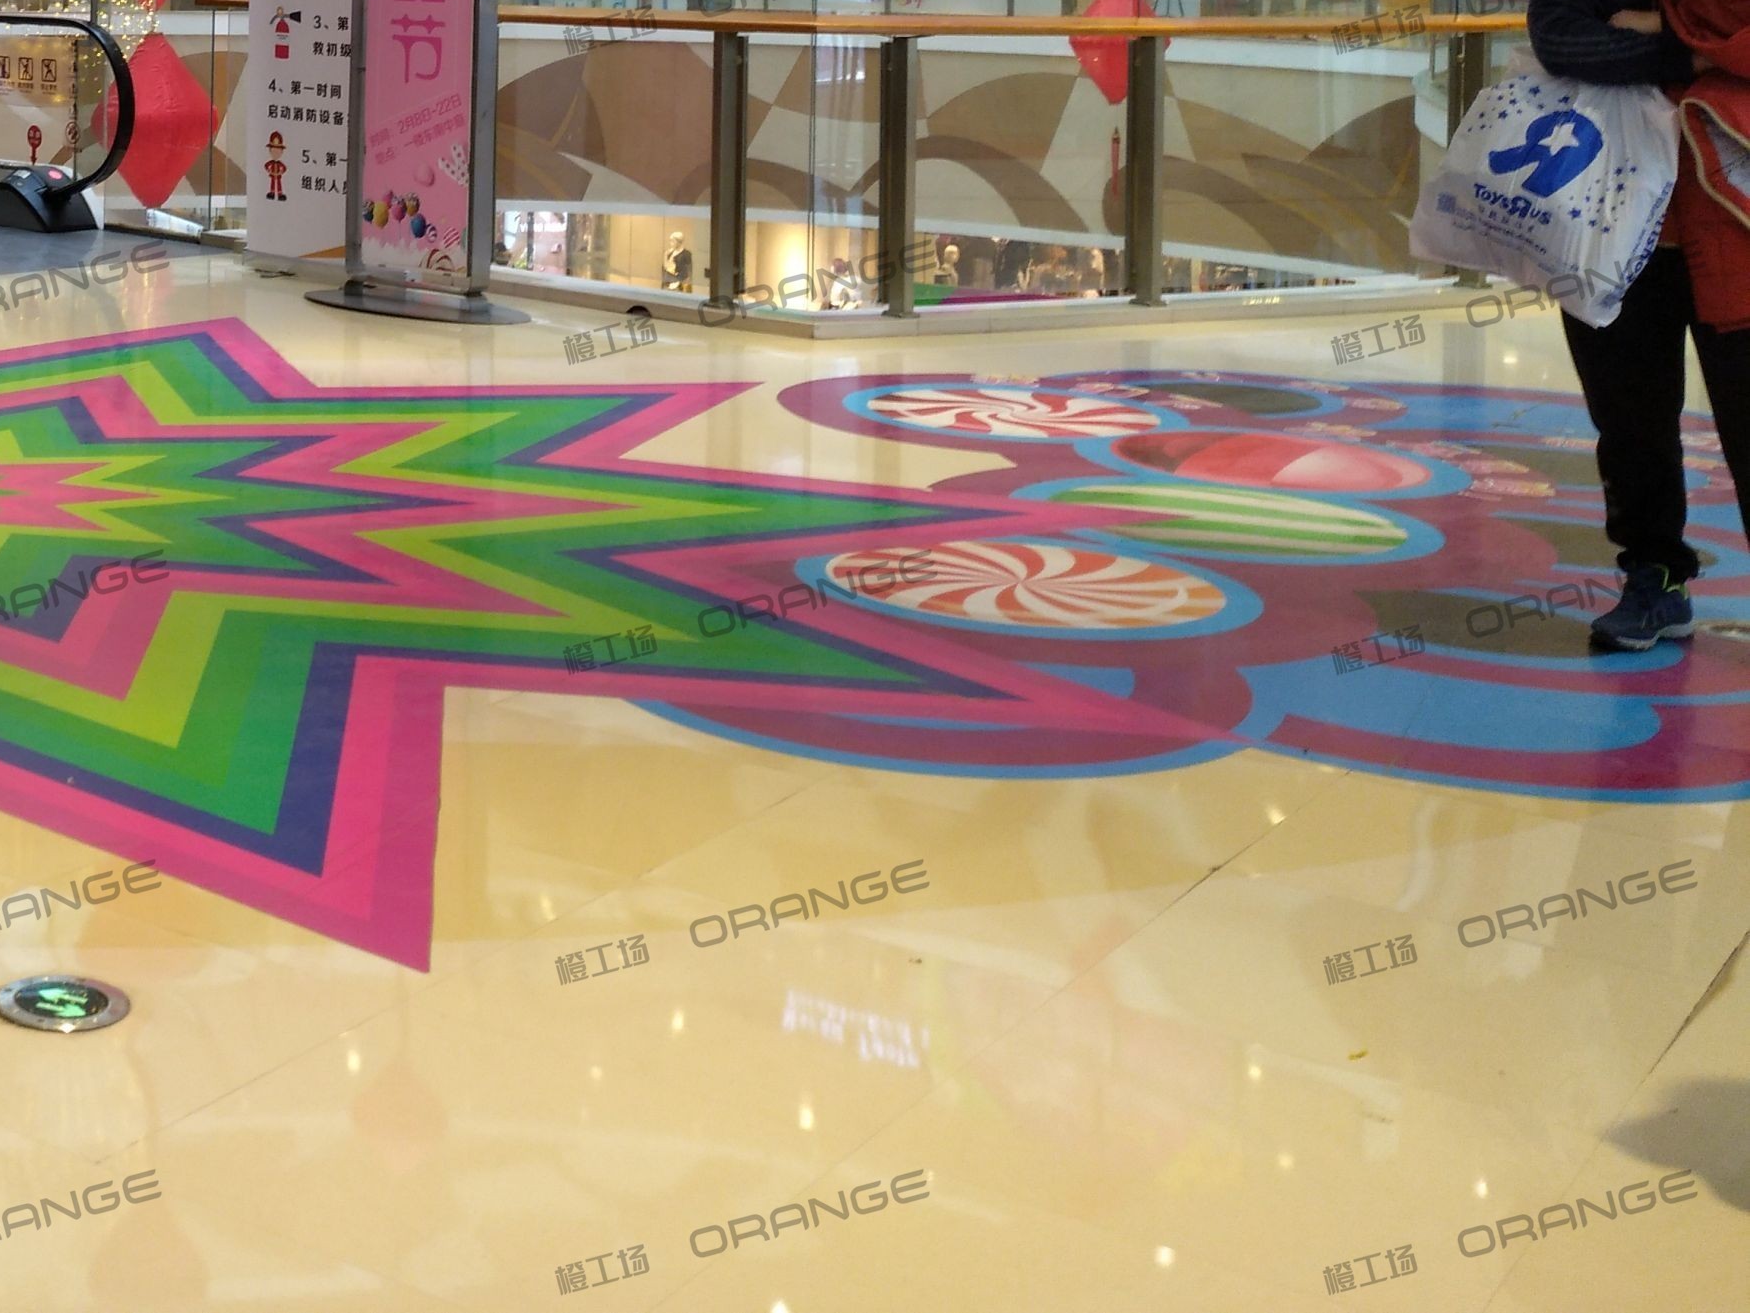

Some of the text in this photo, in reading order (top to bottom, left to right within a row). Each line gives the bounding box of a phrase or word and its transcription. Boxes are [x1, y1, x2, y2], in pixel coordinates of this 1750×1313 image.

[268, 79, 343, 99] 4、第一时间
[268, 104, 350, 126] 启动消防设备
